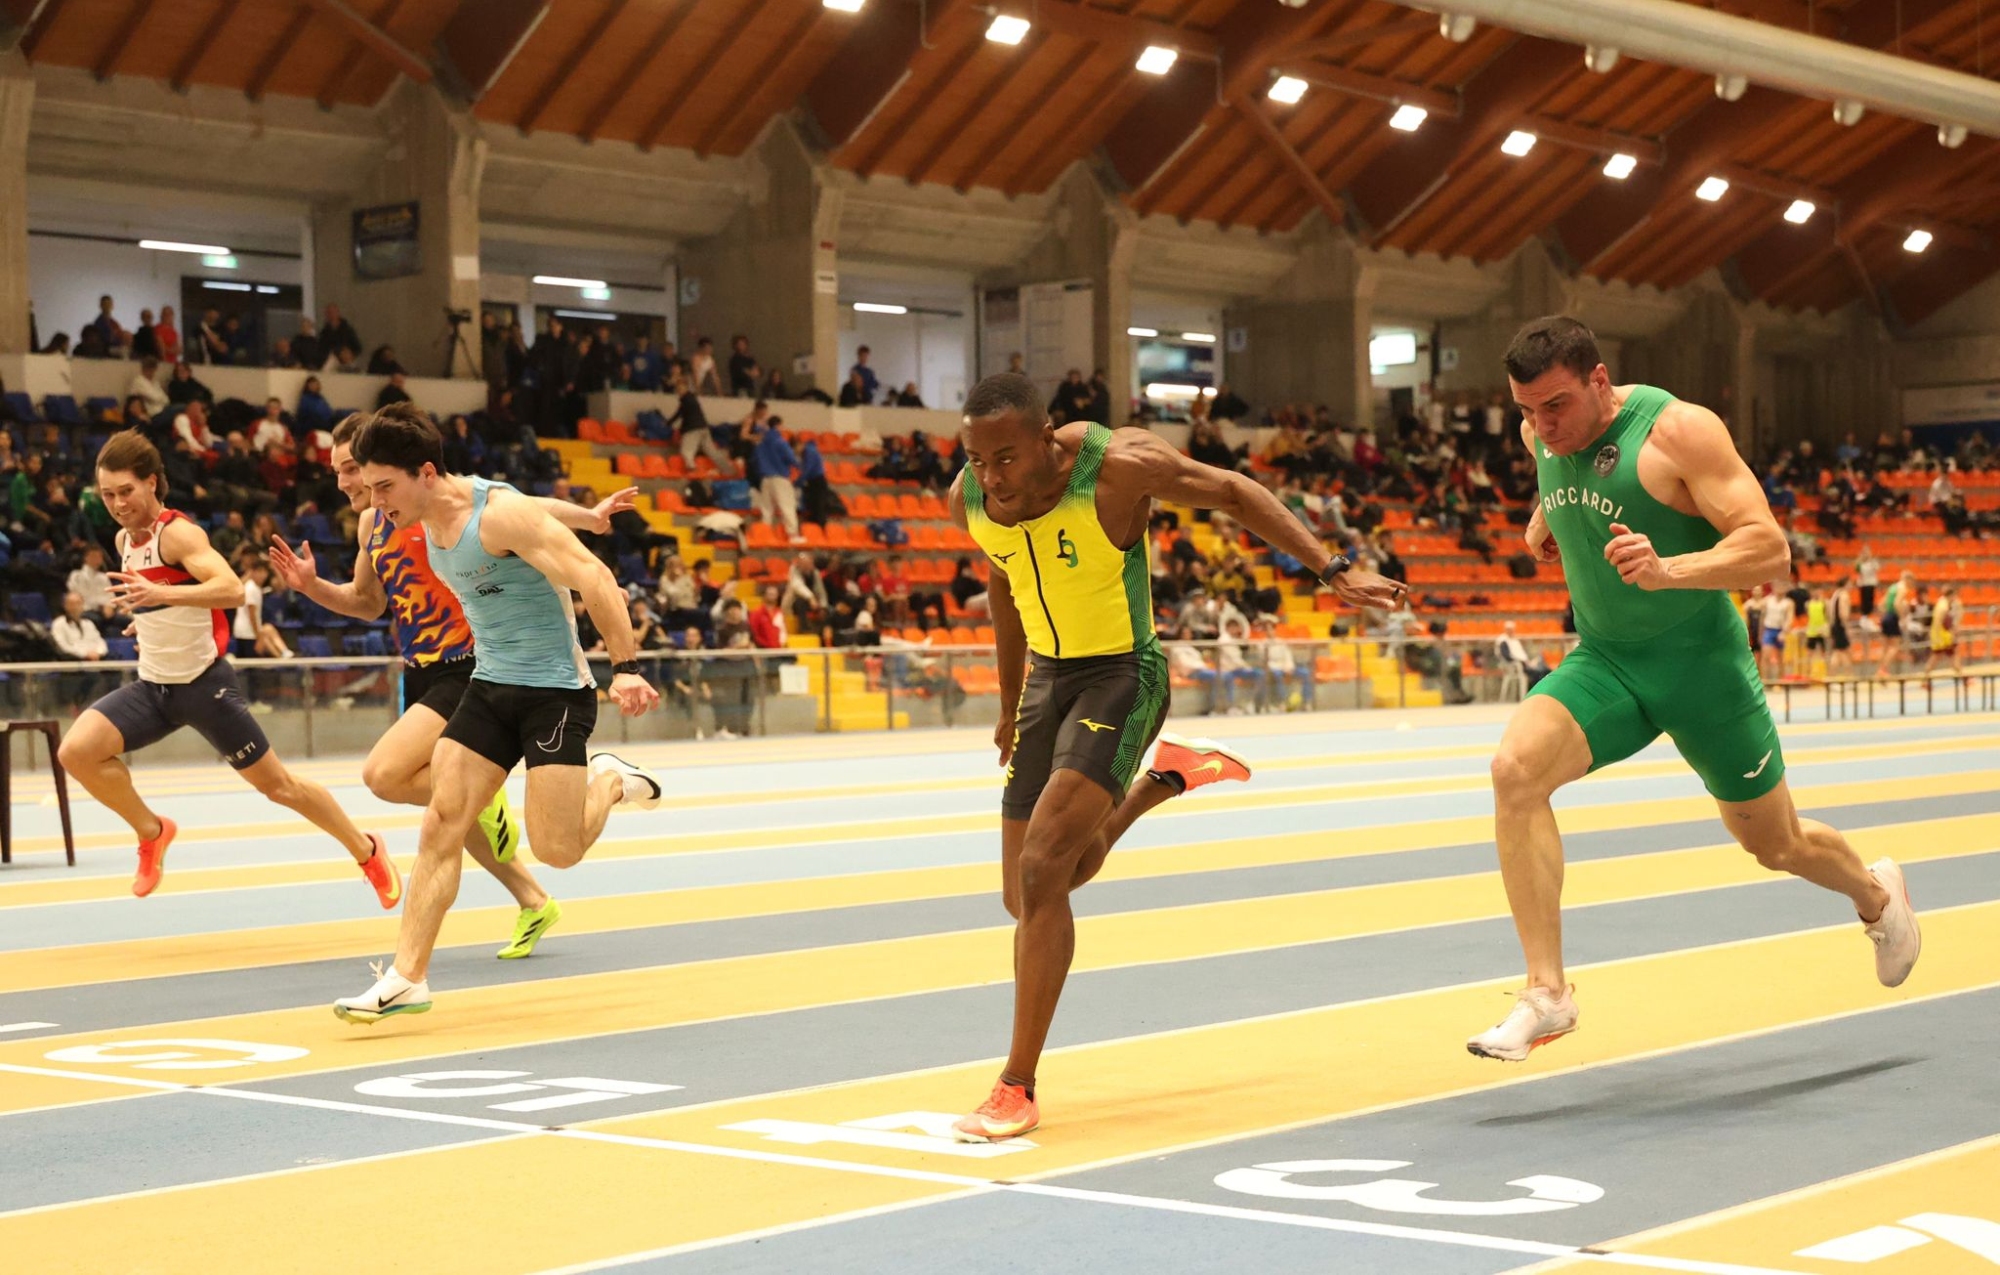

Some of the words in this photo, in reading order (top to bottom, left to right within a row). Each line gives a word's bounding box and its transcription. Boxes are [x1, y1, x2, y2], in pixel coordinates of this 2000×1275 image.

[1544, 486, 1623, 519] RICCARDI
[353, 1070, 686, 1112] 5
[715, 1110, 1041, 1158] 4
[1213, 1159, 1605, 1216] 3
